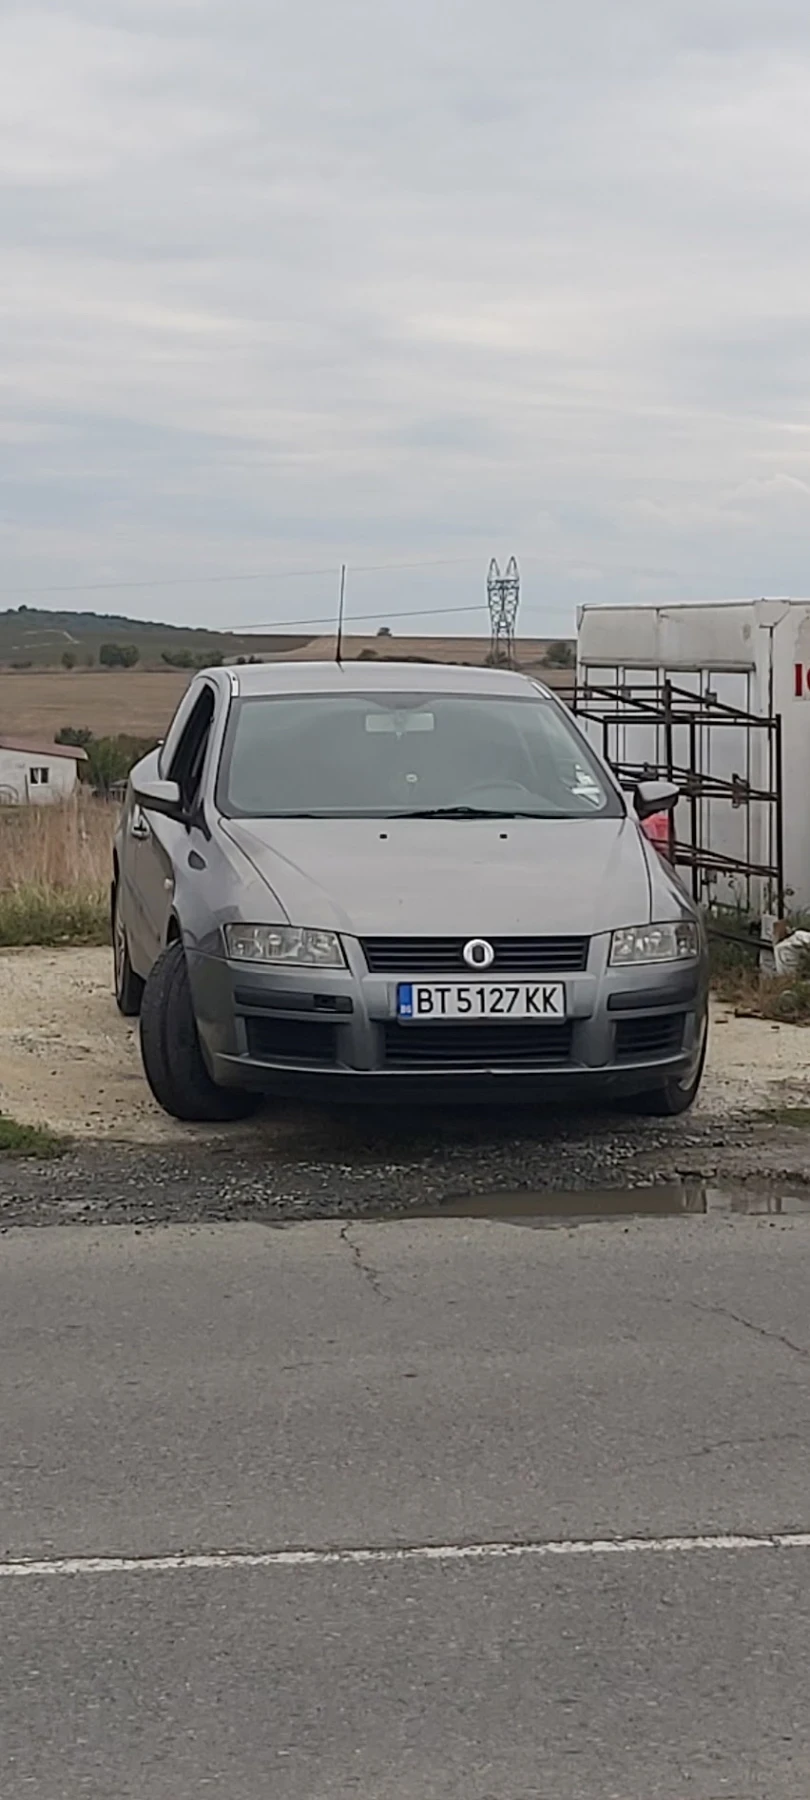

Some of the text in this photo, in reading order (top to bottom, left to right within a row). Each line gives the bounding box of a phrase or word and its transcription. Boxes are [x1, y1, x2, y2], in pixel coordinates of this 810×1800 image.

[417, 987, 558, 1014] BT 5127 KK
